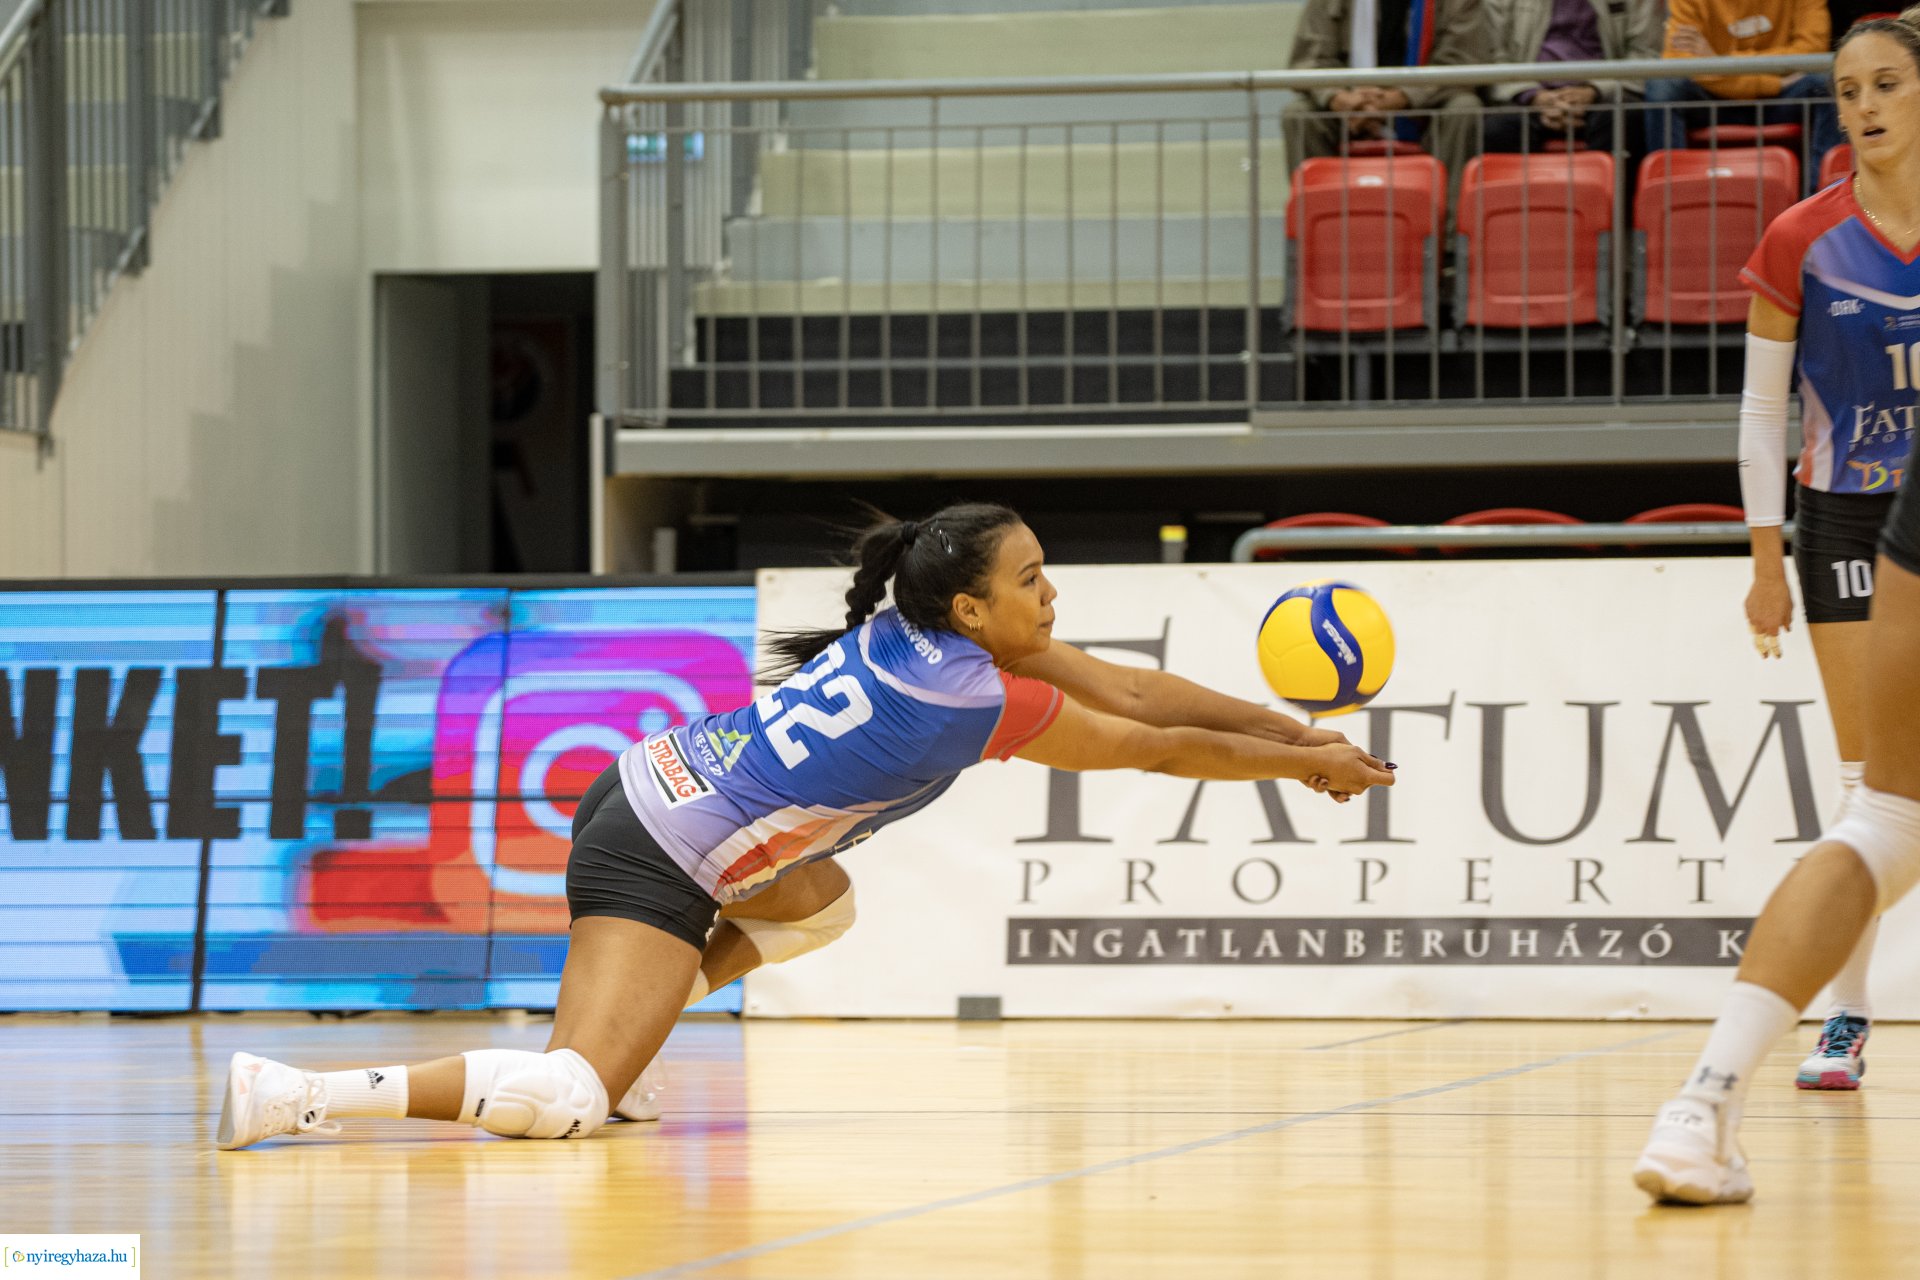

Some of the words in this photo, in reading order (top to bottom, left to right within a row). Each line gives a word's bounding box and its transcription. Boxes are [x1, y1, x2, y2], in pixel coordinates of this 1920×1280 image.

[1831, 559, 1874, 599] 10
[755, 640, 874, 770] 22
[648, 739, 697, 798] STRABAG
[694, 731, 717, 766] KE-VIZ
[1017, 855, 1804, 906] PROPERT
[1016, 922, 1674, 959] INGATLANBERUHÁZÓ
